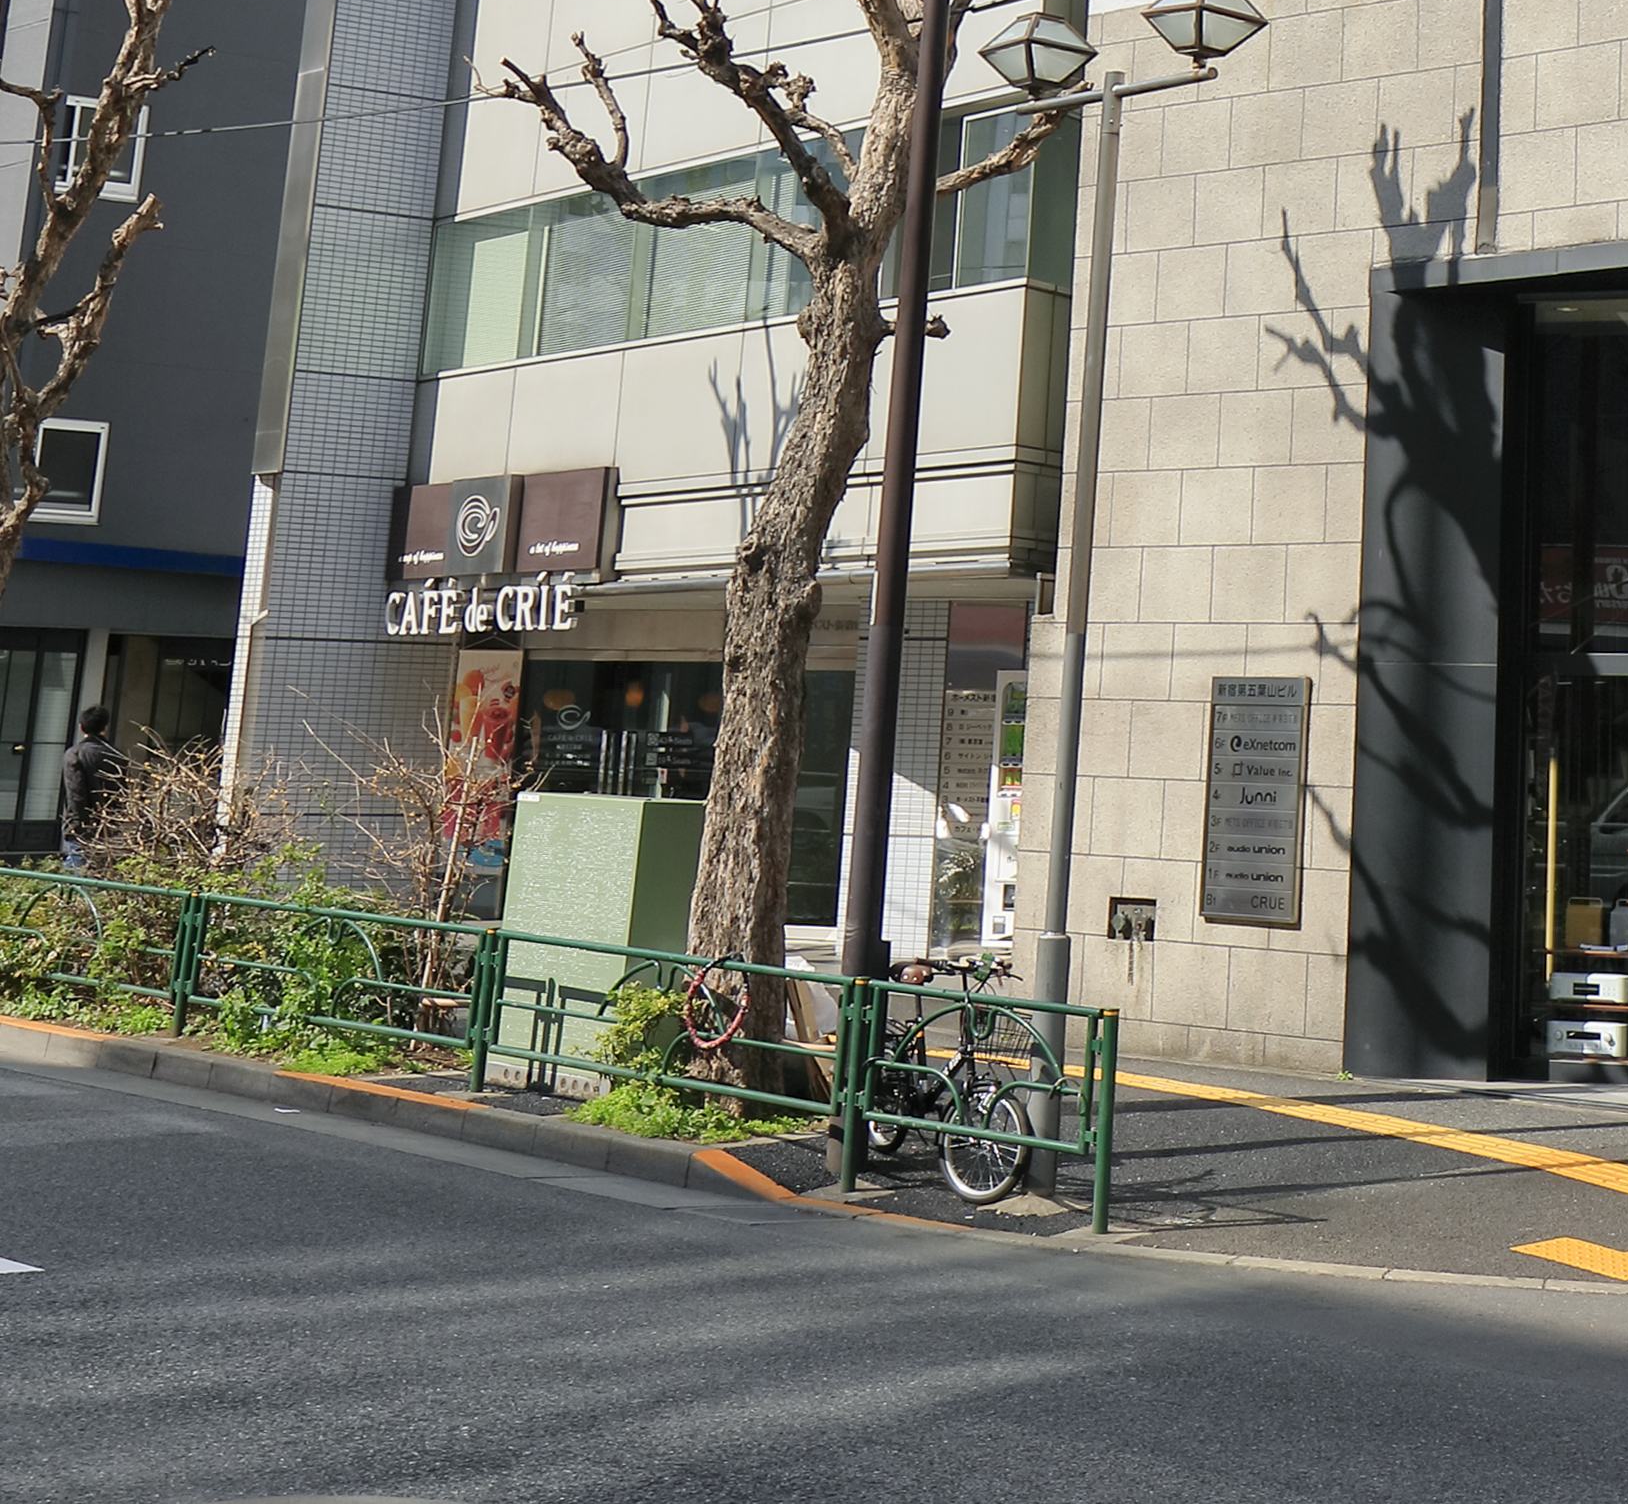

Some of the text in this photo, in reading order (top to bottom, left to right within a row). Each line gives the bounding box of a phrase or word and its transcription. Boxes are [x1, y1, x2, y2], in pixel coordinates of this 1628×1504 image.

[464, 587, 492, 634] de
[947, 708, 954, 717] 9
[1216, 711, 1228, 723] 7F
[946, 722, 953, 731] 8
[1214, 737, 1297, 751] 6F eXnetcom
[944, 751, 951, 760] 6
[943, 766, 950, 775] 5
[1246, 764, 1275, 776] Value
[1278, 767, 1293, 777] Inc.
[1239, 787, 1277, 805] Junni
[1210, 815, 1222, 827] 3F
[1208, 841, 1285, 855] 2F audio union
[1208, 867, 1284, 883] 1F audio union
[1205, 893, 1217, 906] B1
[1250, 895, 1285, 911] CRUE
